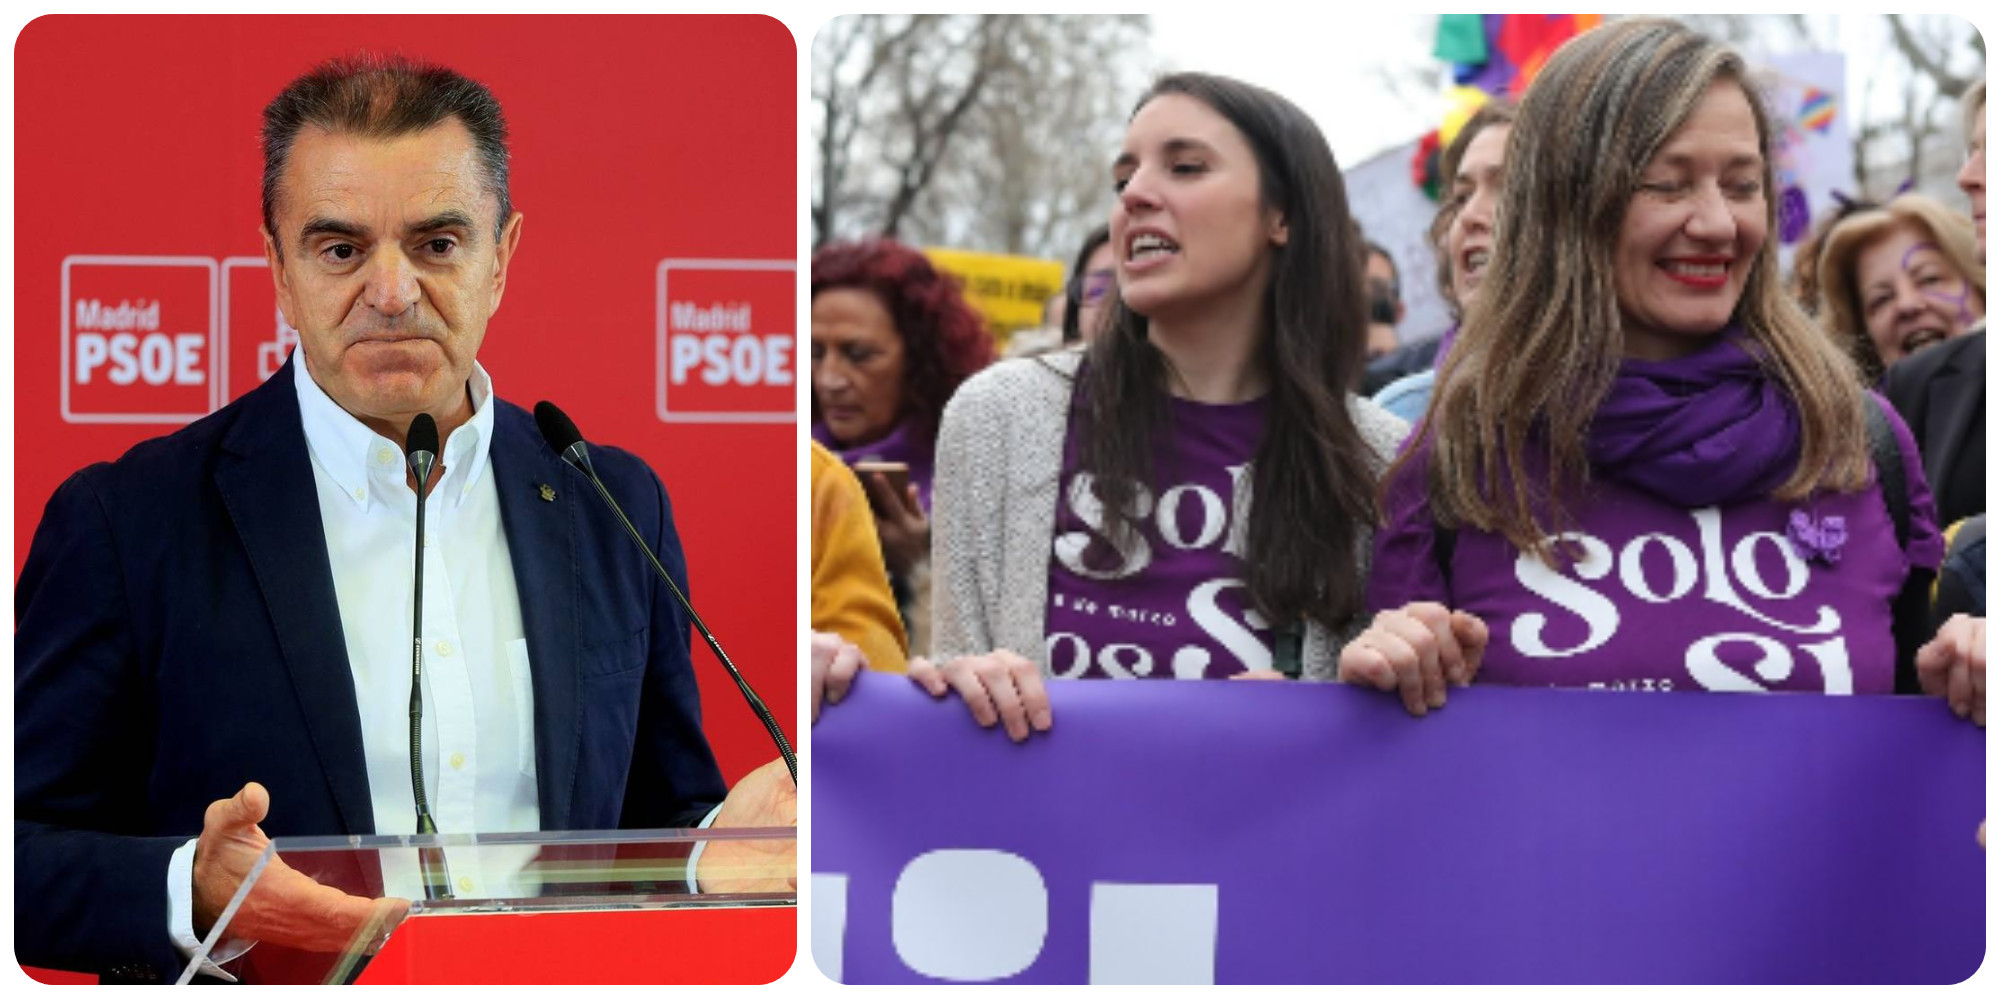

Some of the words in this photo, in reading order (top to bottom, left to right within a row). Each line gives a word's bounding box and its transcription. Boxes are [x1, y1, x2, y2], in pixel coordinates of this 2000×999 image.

[76, 299, 160, 331] Madrid
[670, 300, 752, 332] Madrid
[75, 332, 205, 385] PSOE
[670, 333, 794, 386] PSOE
[1054, 464, 1254, 579] Sol
[1510, 506, 1842, 658] Solo
